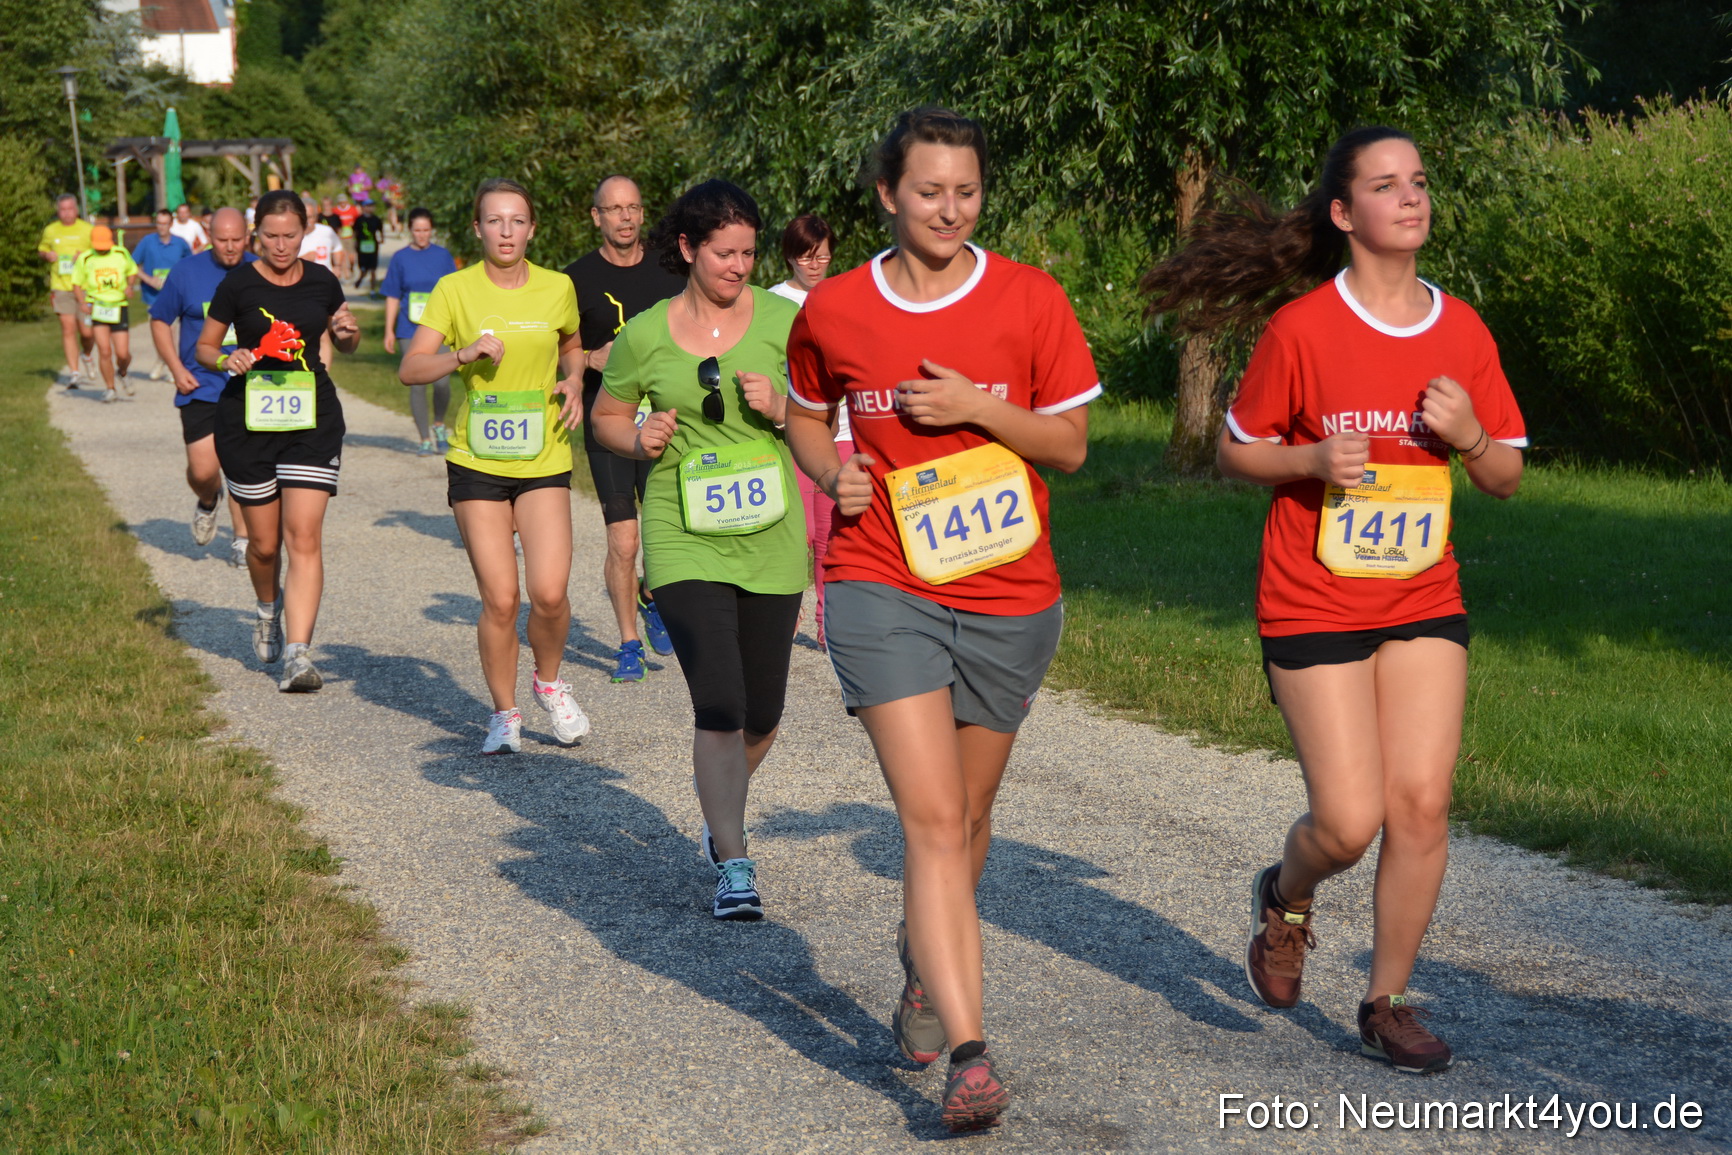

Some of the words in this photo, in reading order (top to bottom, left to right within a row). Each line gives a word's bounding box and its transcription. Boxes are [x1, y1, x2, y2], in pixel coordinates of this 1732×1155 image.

[260, 395, 302, 415] 219
[483, 418, 528, 441] 661
[1398, 438, 1428, 447] STARKE
[705, 477, 767, 513] 518
[911, 475, 957, 496] firmenlauf
[716, 517, 741, 525] Yvonne
[740, 513, 761, 522] Kaiser
[915, 489, 1025, 551] 1412
[1337, 508, 1432, 548] 1411
[939, 549, 978, 565] Franziska
[978, 537, 1014, 553] Spangler
